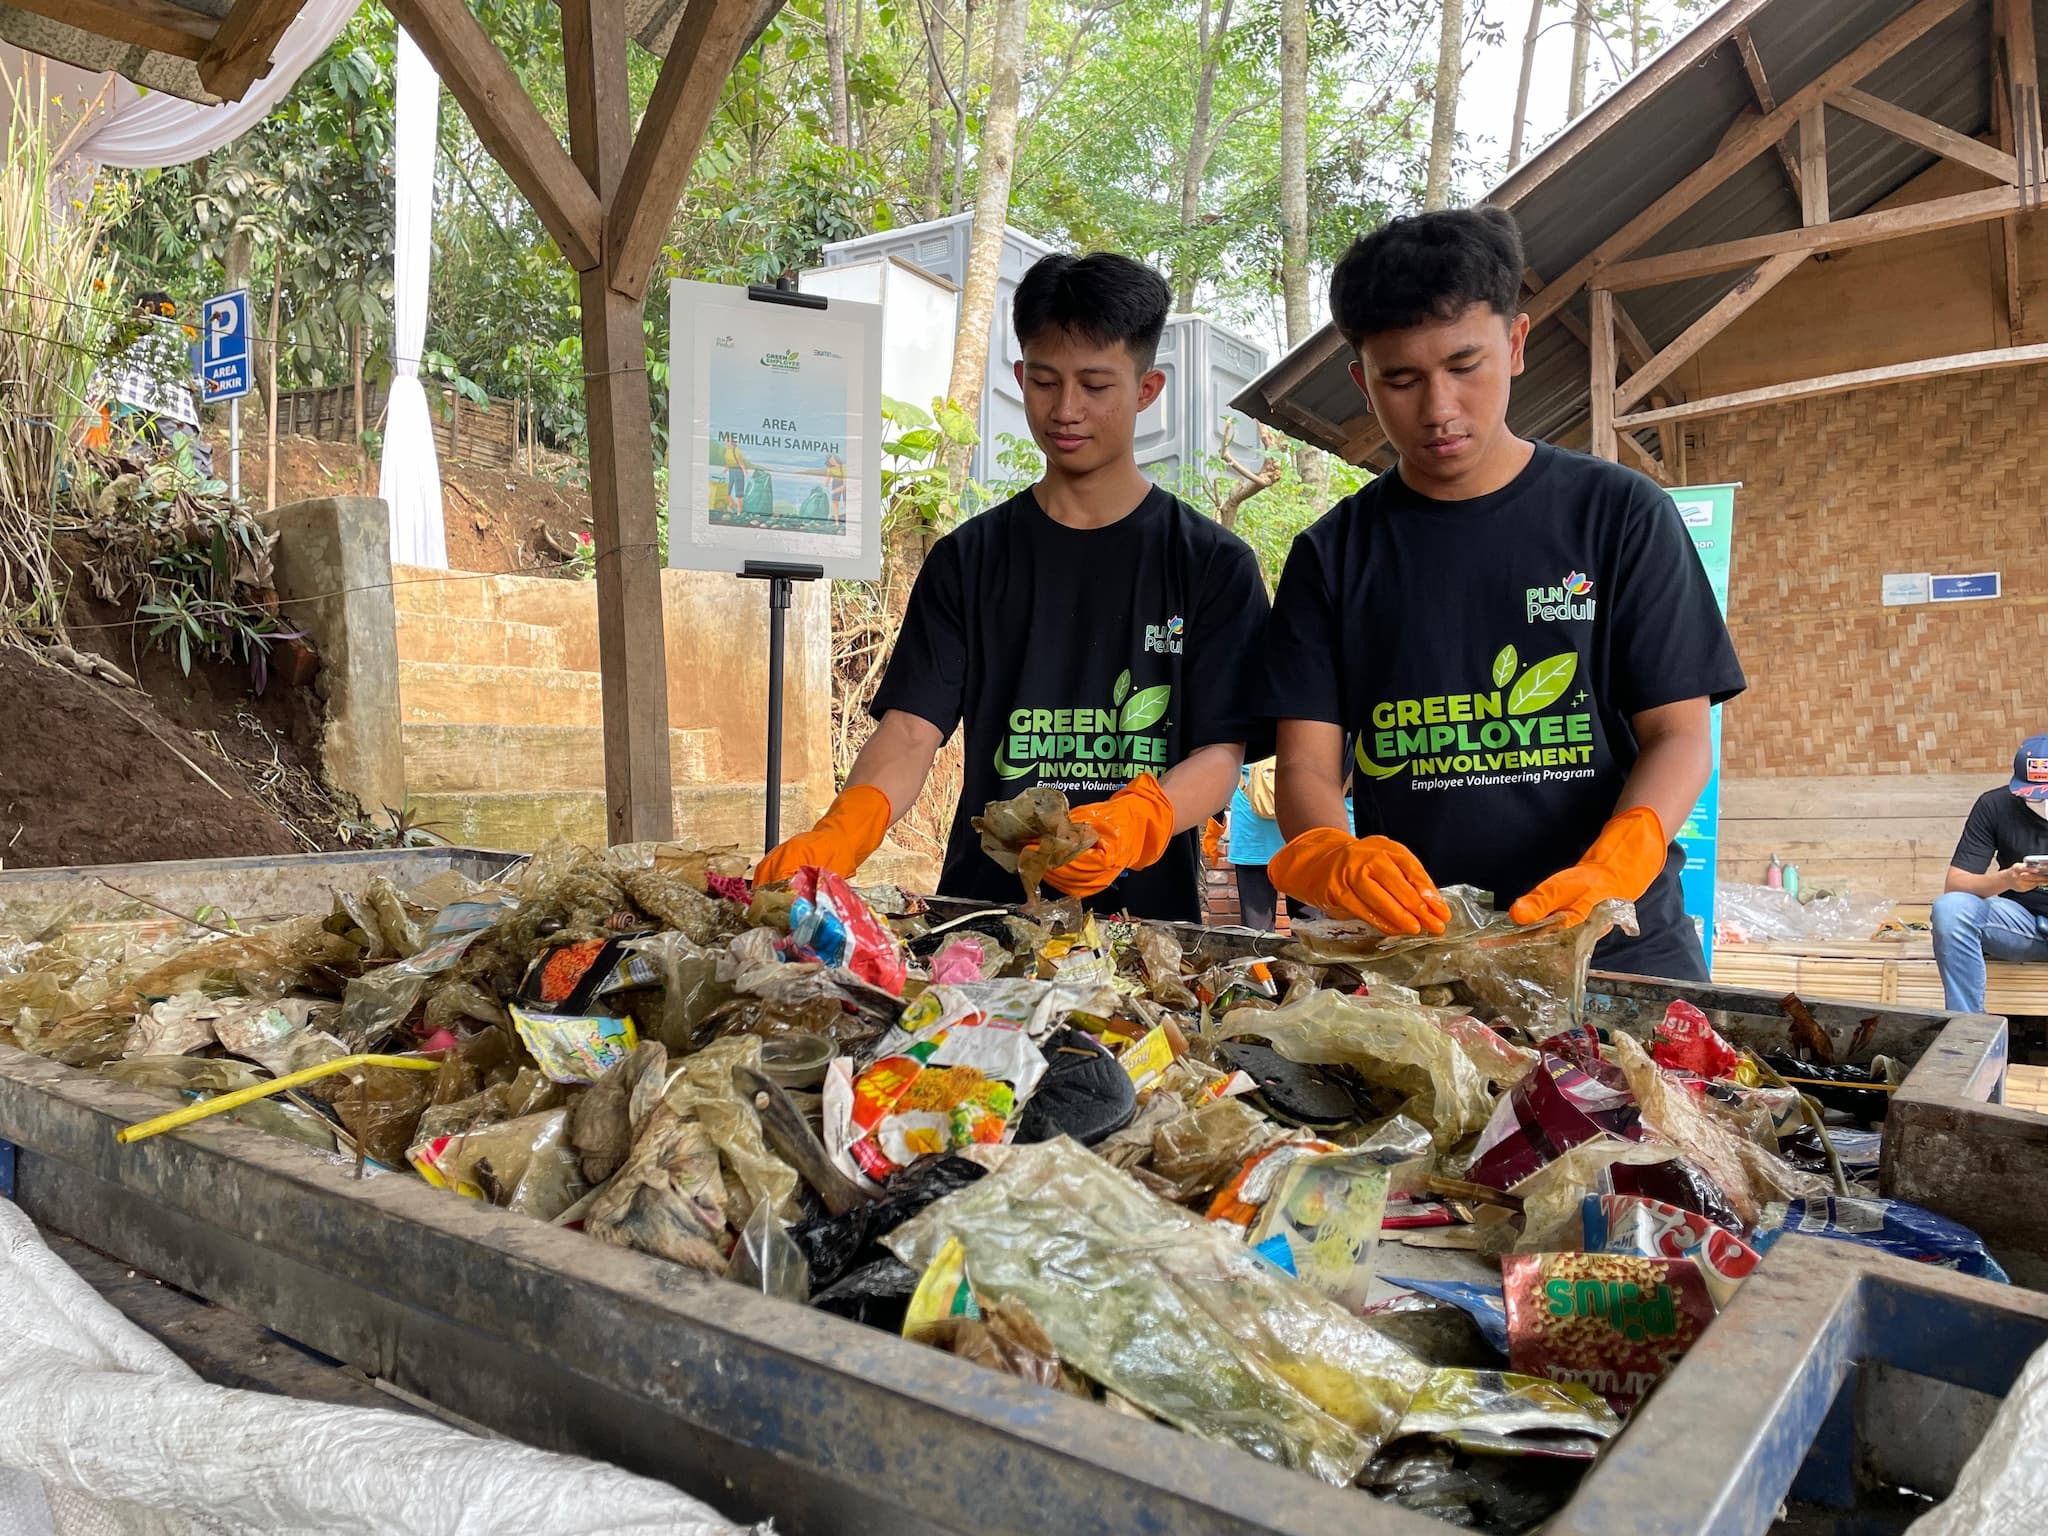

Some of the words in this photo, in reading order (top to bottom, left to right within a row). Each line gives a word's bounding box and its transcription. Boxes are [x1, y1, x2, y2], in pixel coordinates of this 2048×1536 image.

[212, 301, 238, 359] P
[766, 353, 788, 361] GREEN
[213, 364, 237, 378] AREA
[209, 377, 242, 392] RKIR
[762, 418, 797, 432] AREA
[718, 431, 782, 449] MEMILAH
[784, 438, 839, 454] SAMPAH
[1526, 586, 1564, 603] PLN
[1527, 599, 1597, 623] Peduli
[1009, 708, 1118, 734] GREEN
[1372, 692, 1503, 730] GREEN
[1374, 713, 1593, 759] EMPLOYEE
[1009, 735, 1168, 763] EMPLOYEE
[1411, 746, 1594, 776] INVOLVEMENT
[1411, 777, 1464, 791] Employee
[1466, 771, 1541, 787] Volunteering
[1543, 768, 1595, 783] Program
[1545, 1279, 1676, 1342] Pilus
